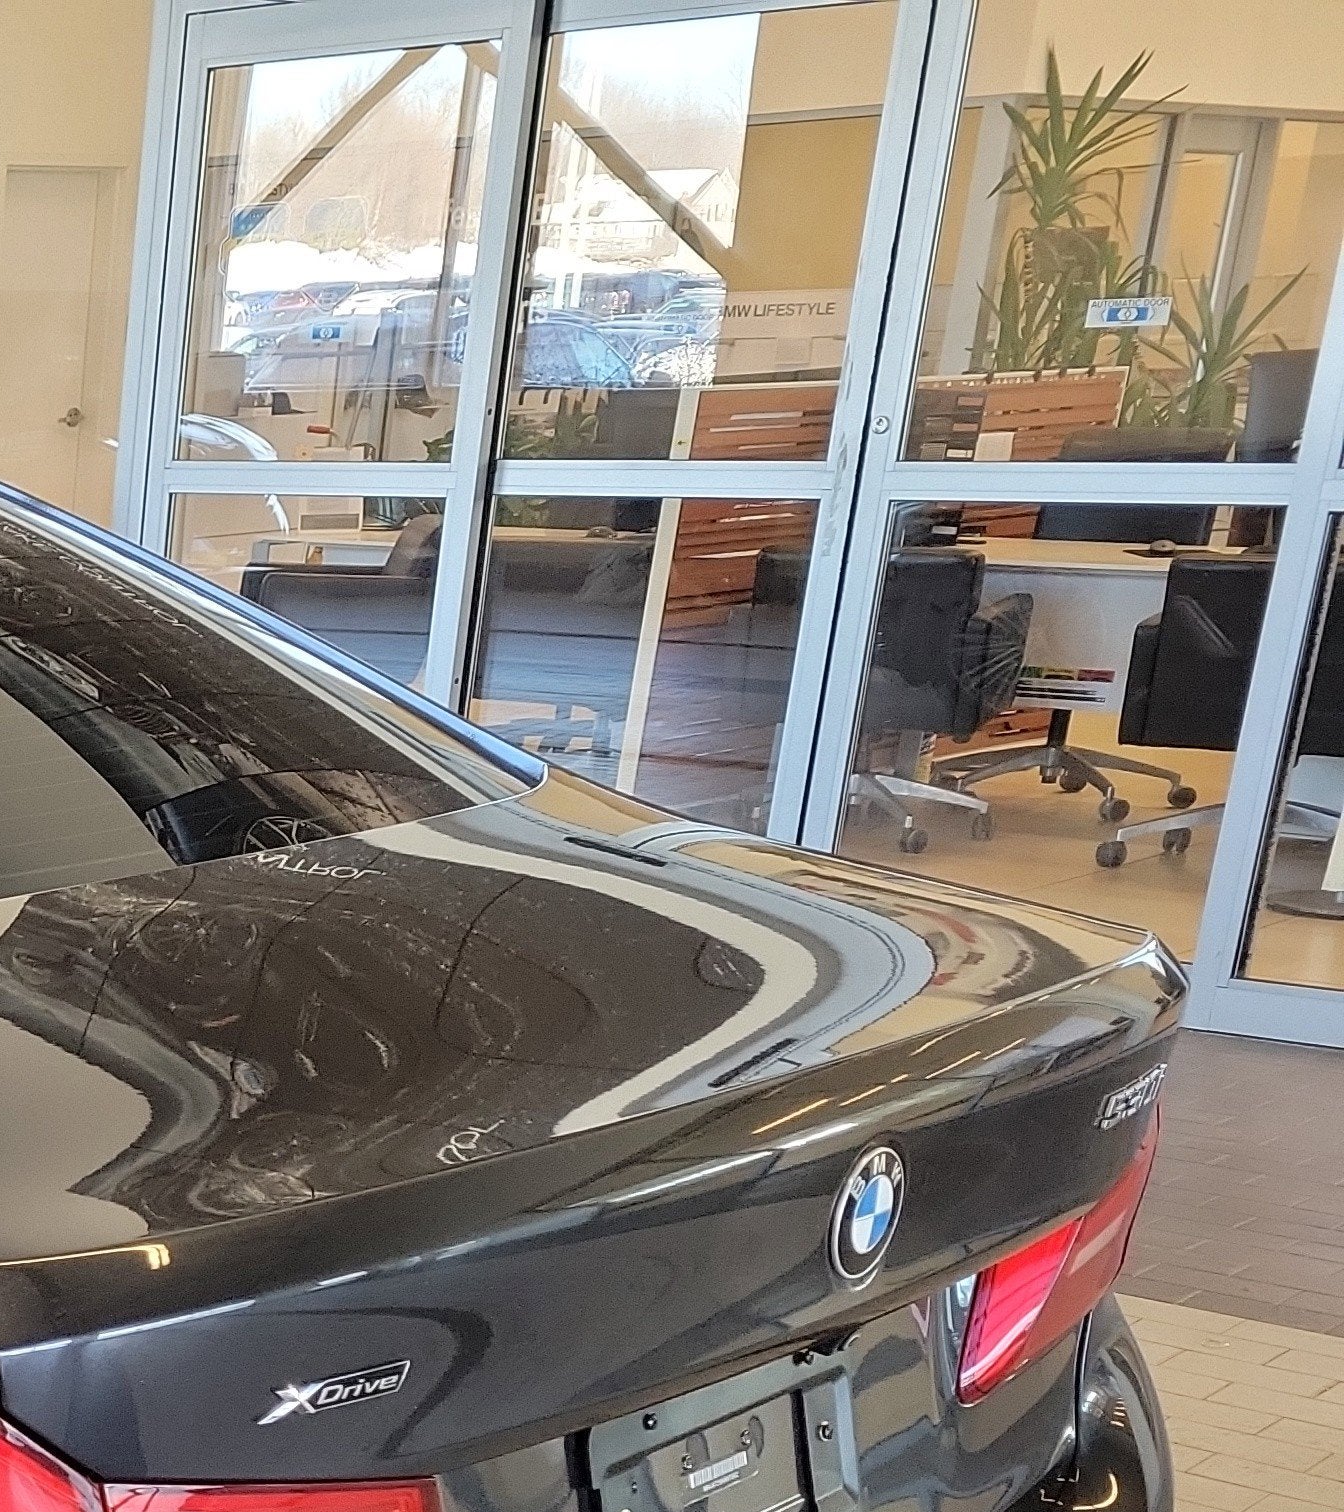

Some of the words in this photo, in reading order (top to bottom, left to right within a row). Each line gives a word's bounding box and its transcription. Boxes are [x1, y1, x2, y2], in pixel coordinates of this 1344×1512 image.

[1091, 299, 1141, 308] AUTOMATIC
[1143, 298, 1169, 307] DOOR
[753, 302, 837, 317] LIFESTYLE
